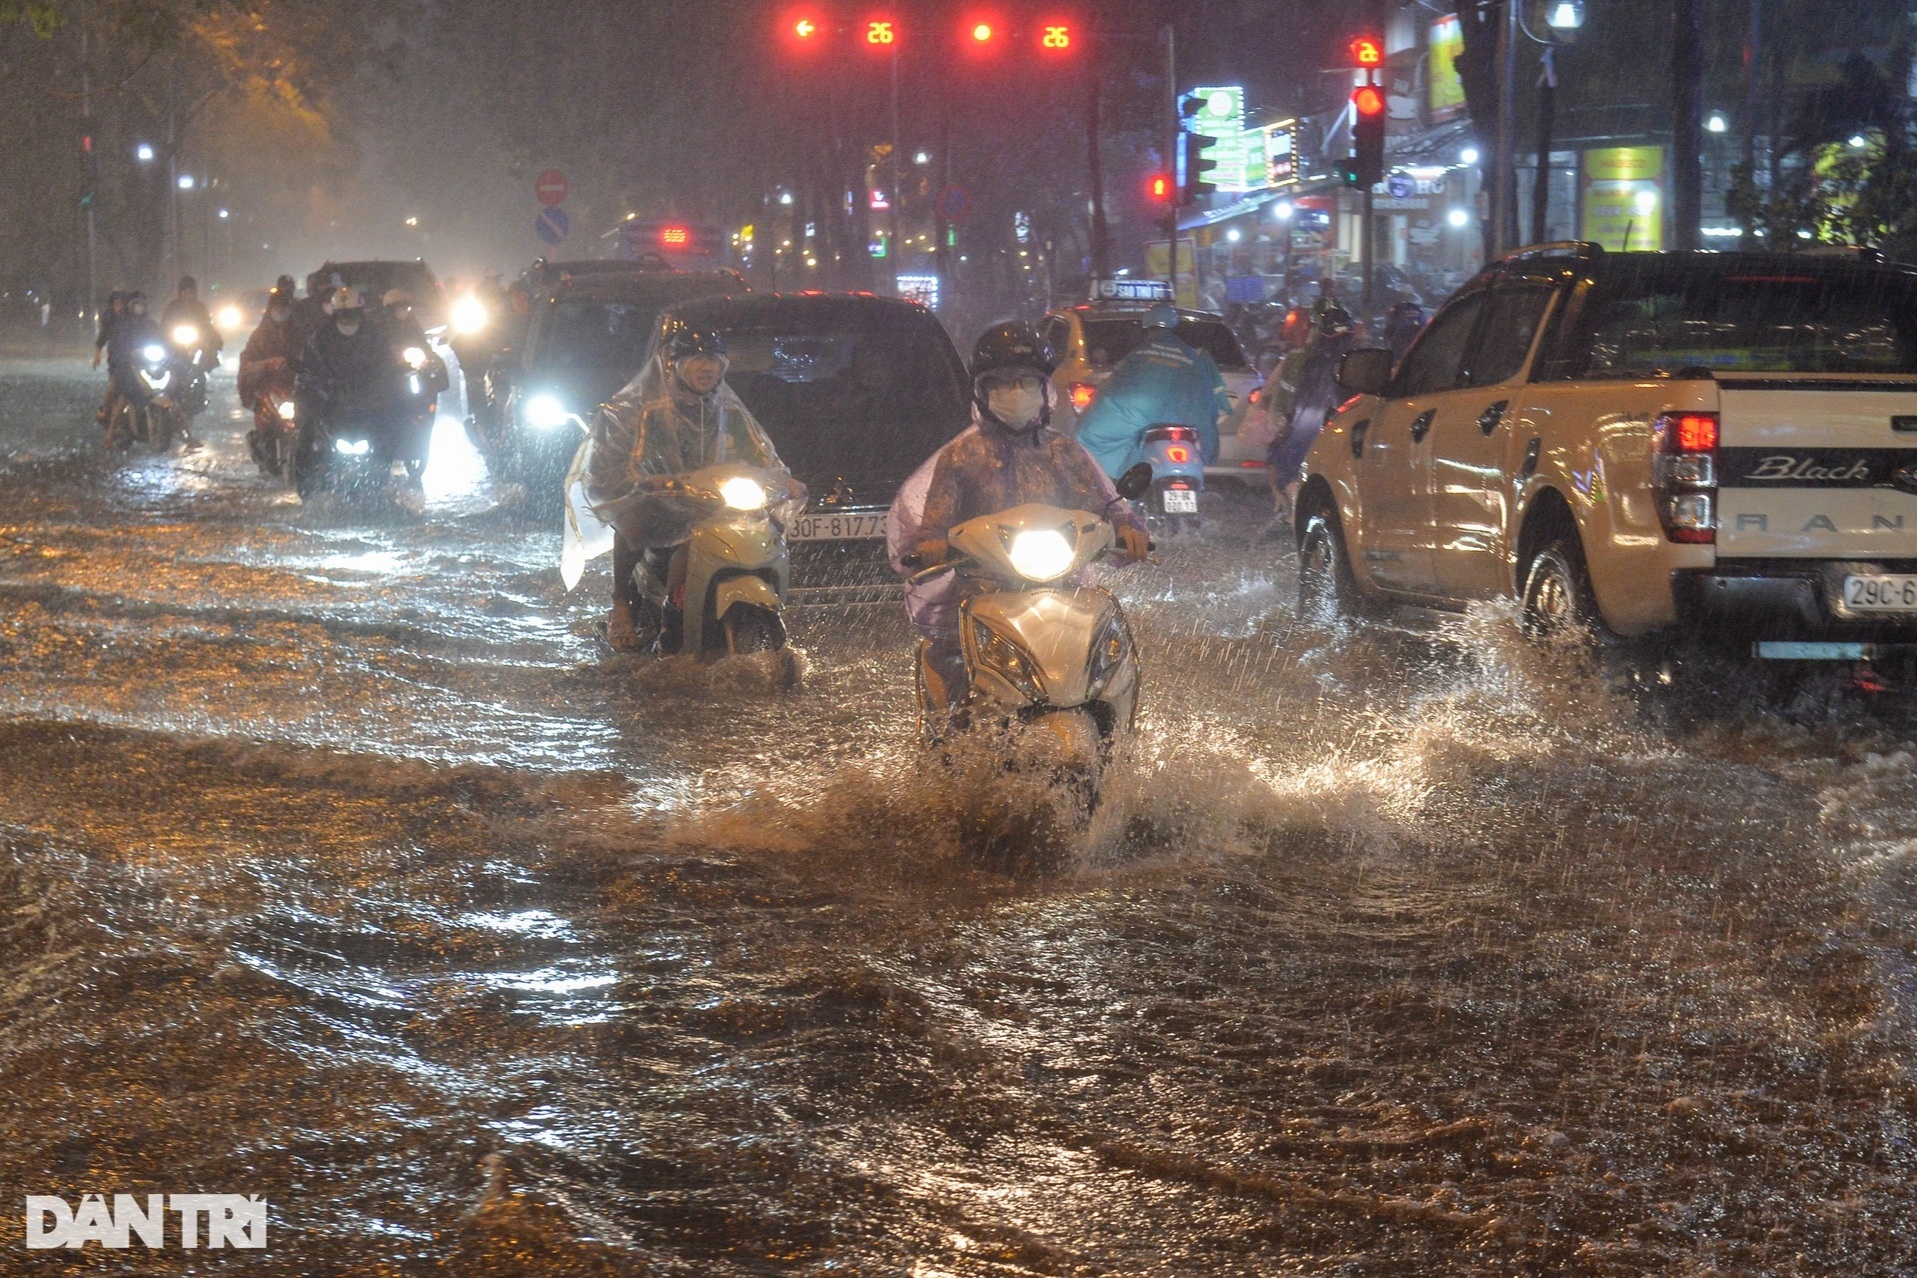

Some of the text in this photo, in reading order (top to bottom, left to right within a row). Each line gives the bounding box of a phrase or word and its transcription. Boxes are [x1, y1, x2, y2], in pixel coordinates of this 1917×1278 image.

[867, 22, 894, 44] 26
[1043, 26, 1069, 48] 26
[1743, 456, 1870, 480] Black
[1851, 580, 1917, 606] 29C-6
